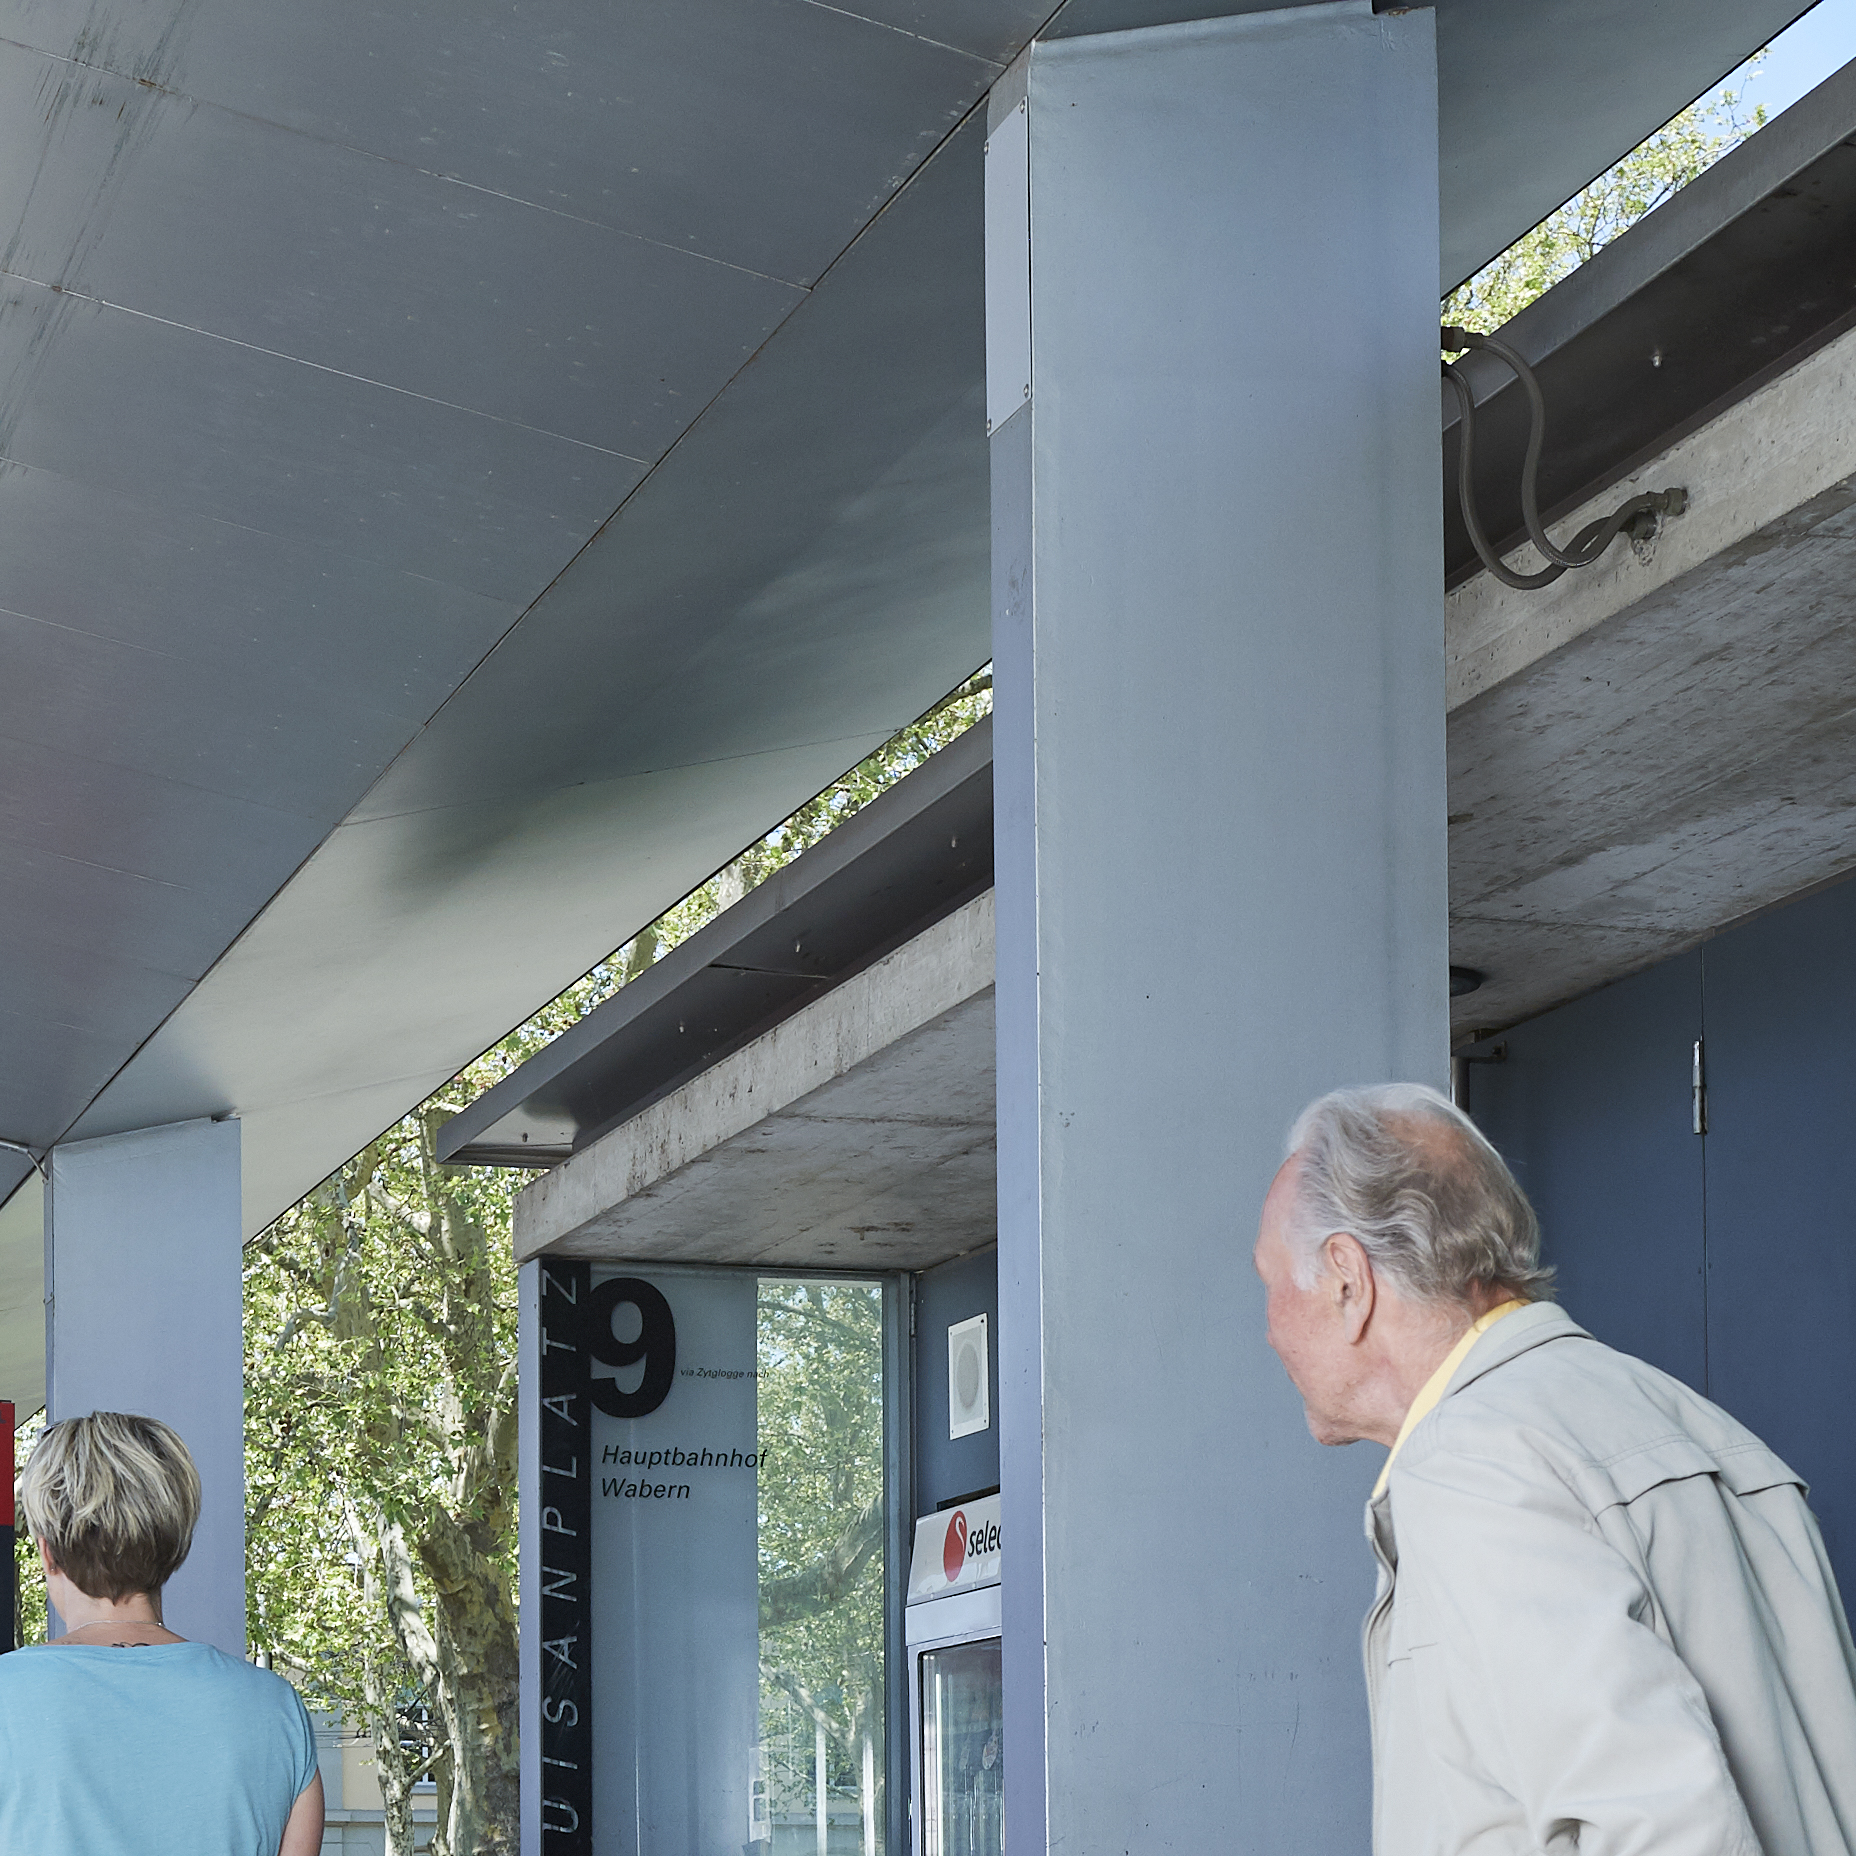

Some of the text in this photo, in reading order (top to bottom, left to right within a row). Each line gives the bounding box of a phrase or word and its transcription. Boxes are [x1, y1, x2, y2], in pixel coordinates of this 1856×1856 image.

[581, 1276, 677, 1419] 9
[680, 1367, 770, 1379] via Zytglogge nach
[601, 1444, 768, 1470] Hauptbahnhof
[601, 1477, 691, 1499] Wabern
